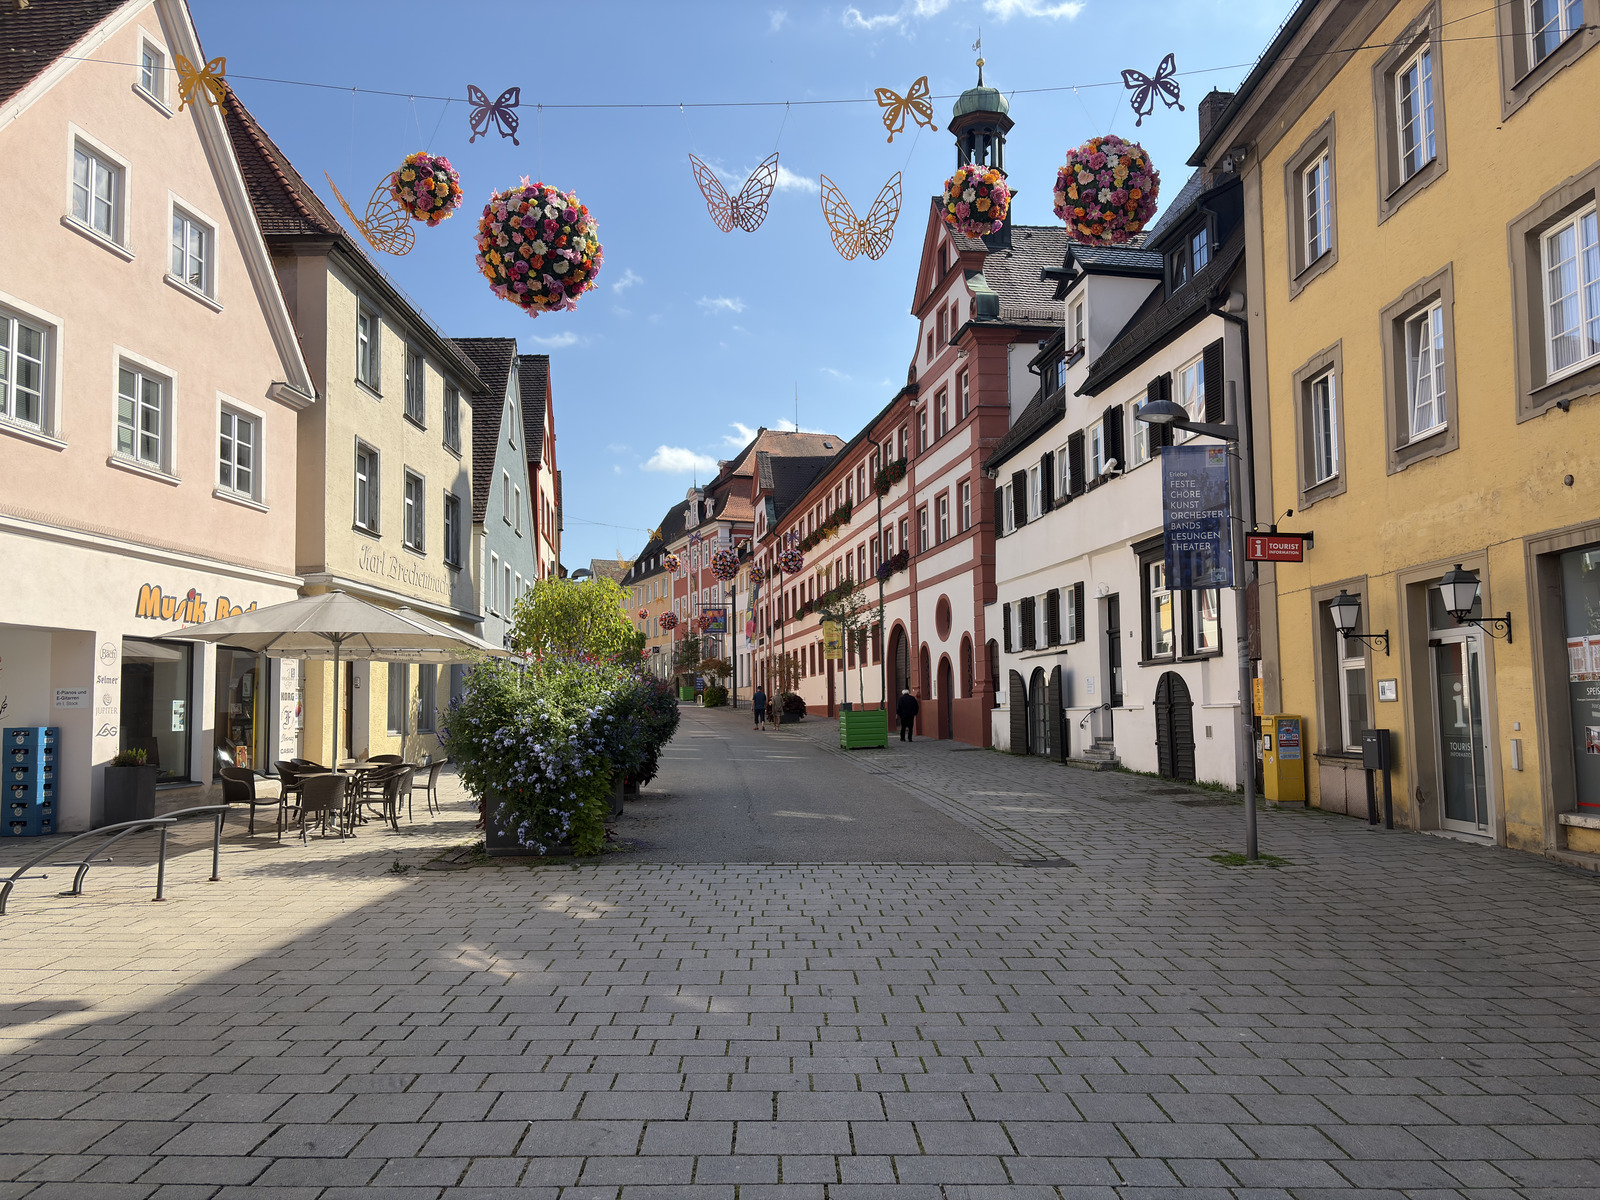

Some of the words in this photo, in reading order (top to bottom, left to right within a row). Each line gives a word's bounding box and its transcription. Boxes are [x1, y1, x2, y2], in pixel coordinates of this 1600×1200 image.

[1170, 480, 1196, 488] FESTE
[1170, 500, 1199, 509] KUNST
[1170, 510, 1224, 520] ORCHESTER
[1171, 521, 1201, 530] BANDS
[1171, 531, 1221, 541] LESUNGEN
[1171, 542, 1211, 551] THEATER
[359, 545, 385, 576] Karl
[135, 582, 208, 625] Musik
[96, 675, 119, 685] Selmer
[281, 692, 295, 701] KORG
[95, 706, 119, 716] JUPITER
[1450, 742, 1472, 751] TOURIS
